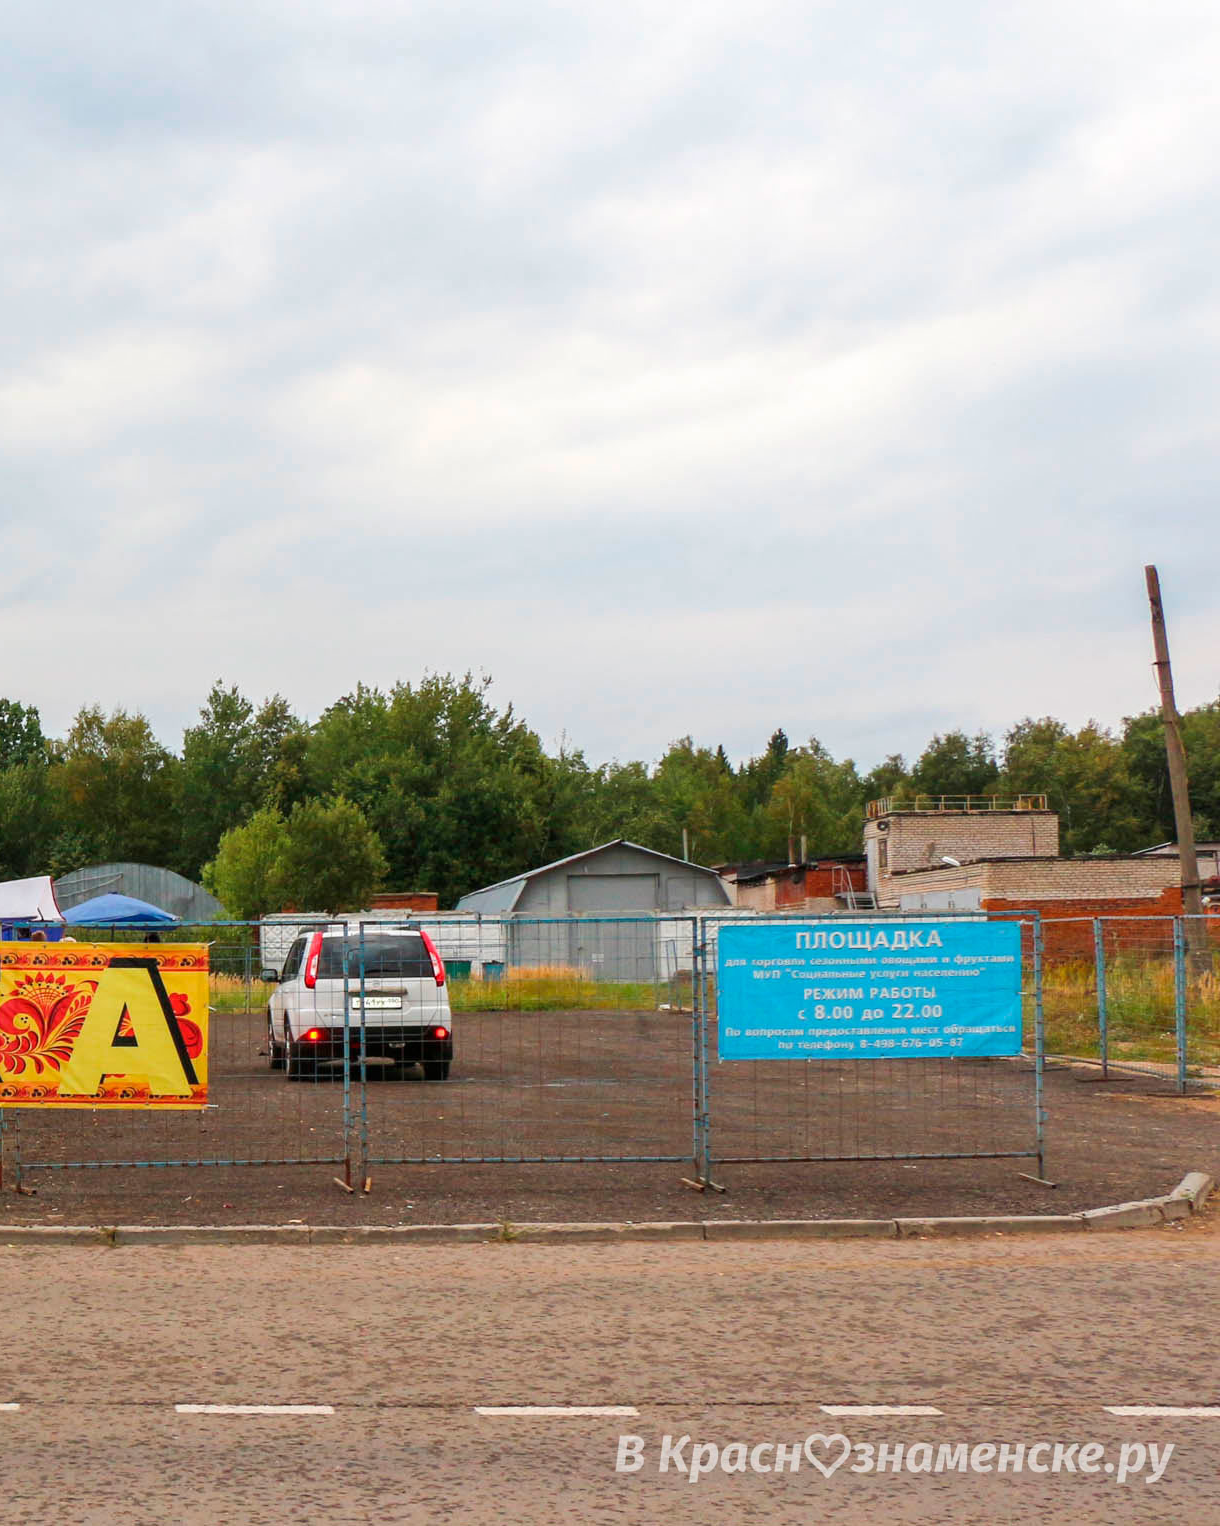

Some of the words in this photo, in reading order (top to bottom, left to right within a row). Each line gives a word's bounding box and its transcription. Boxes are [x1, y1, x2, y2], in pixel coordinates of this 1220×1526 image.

[795, 930, 943, 951] ПЛОЩАДКА
[724, 958, 746, 967] для
[810, 956, 877, 966] сезонными
[881, 956, 938, 966] овощами
[942, 956, 950, 964] и
[953, 954, 1015, 965] фруктами
[752, 969, 781, 979] МУП
[870, 969, 909, 980] услуги
[803, 988, 864, 1000] РЕЖИМ
[869, 986, 937, 999] РАБОТЫ
[797, 1009, 806, 1020] с
[814, 1004, 853, 1020] 8.00
[861, 1008, 884, 1021] до
[891, 1003, 943, 1019] 22.00
[745, 1027, 805, 1038] вопросам
[808, 1026, 907, 1038] предоставления
[943, 1024, 1016, 1035] обращаться
[797, 1039, 855, 1050] телефону
